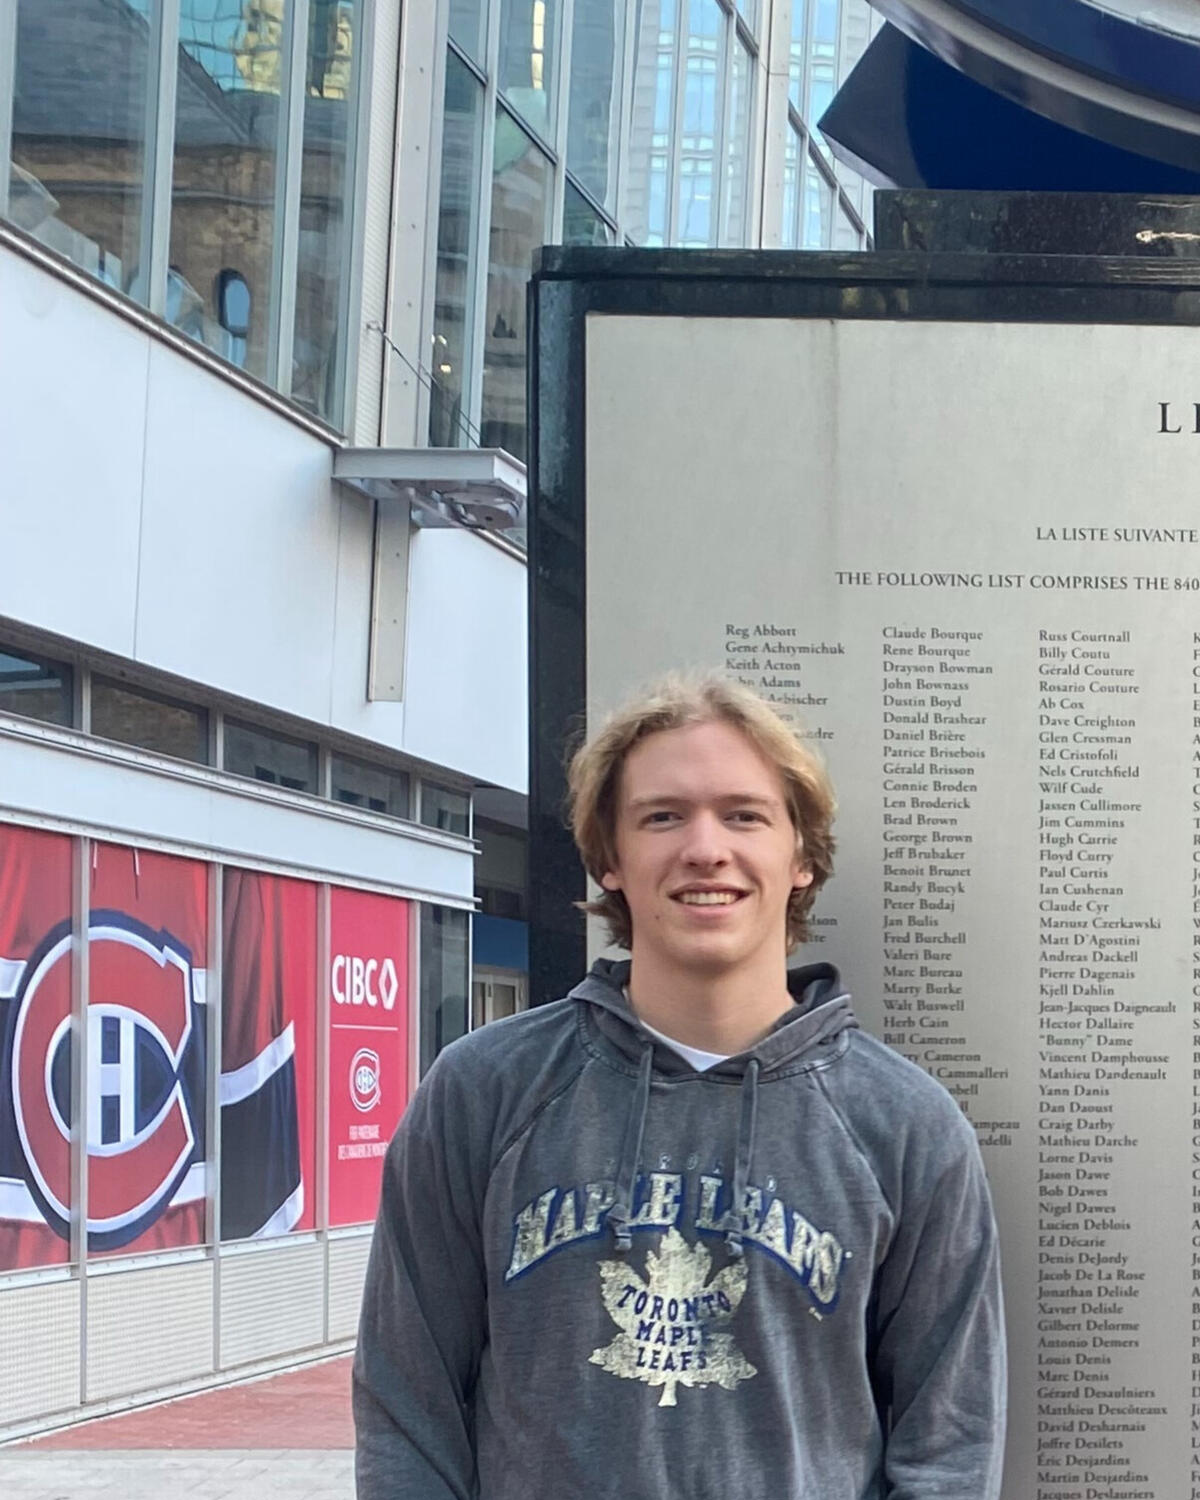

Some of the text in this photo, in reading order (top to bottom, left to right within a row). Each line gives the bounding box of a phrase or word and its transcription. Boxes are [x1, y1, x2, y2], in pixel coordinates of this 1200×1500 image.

[1036, 526, 1057, 541] LA
[1062, 527, 1109, 542] LISTE
[1113, 527, 1199, 543] SUIVANTE
[834, 571, 873, 586] THE
[877, 572, 983, 588] FOLLOWING
[988, 574, 1026, 589] LIST
[1029, 574, 1129, 590] COMPRISES
[1132, 576, 1170, 591] THE
[1173, 577, 1200, 591] 840
[882, 626, 984, 644] Claude Bourque
[725, 640, 759, 654] Gene
[1039, 680, 1140, 694] Rosario Couture
[883, 796, 971, 809] Len Broderick
[1039, 849, 1074, 865] Floyd
[331, 954, 378, 1006] CIBC
[883, 1015, 949, 1029] Herb Cain
[1038, 1051, 1170, 1067] Vincent Damphousse
[616, 1283, 732, 1323] TORONTO
[635, 1346, 708, 1372] LEAFS
